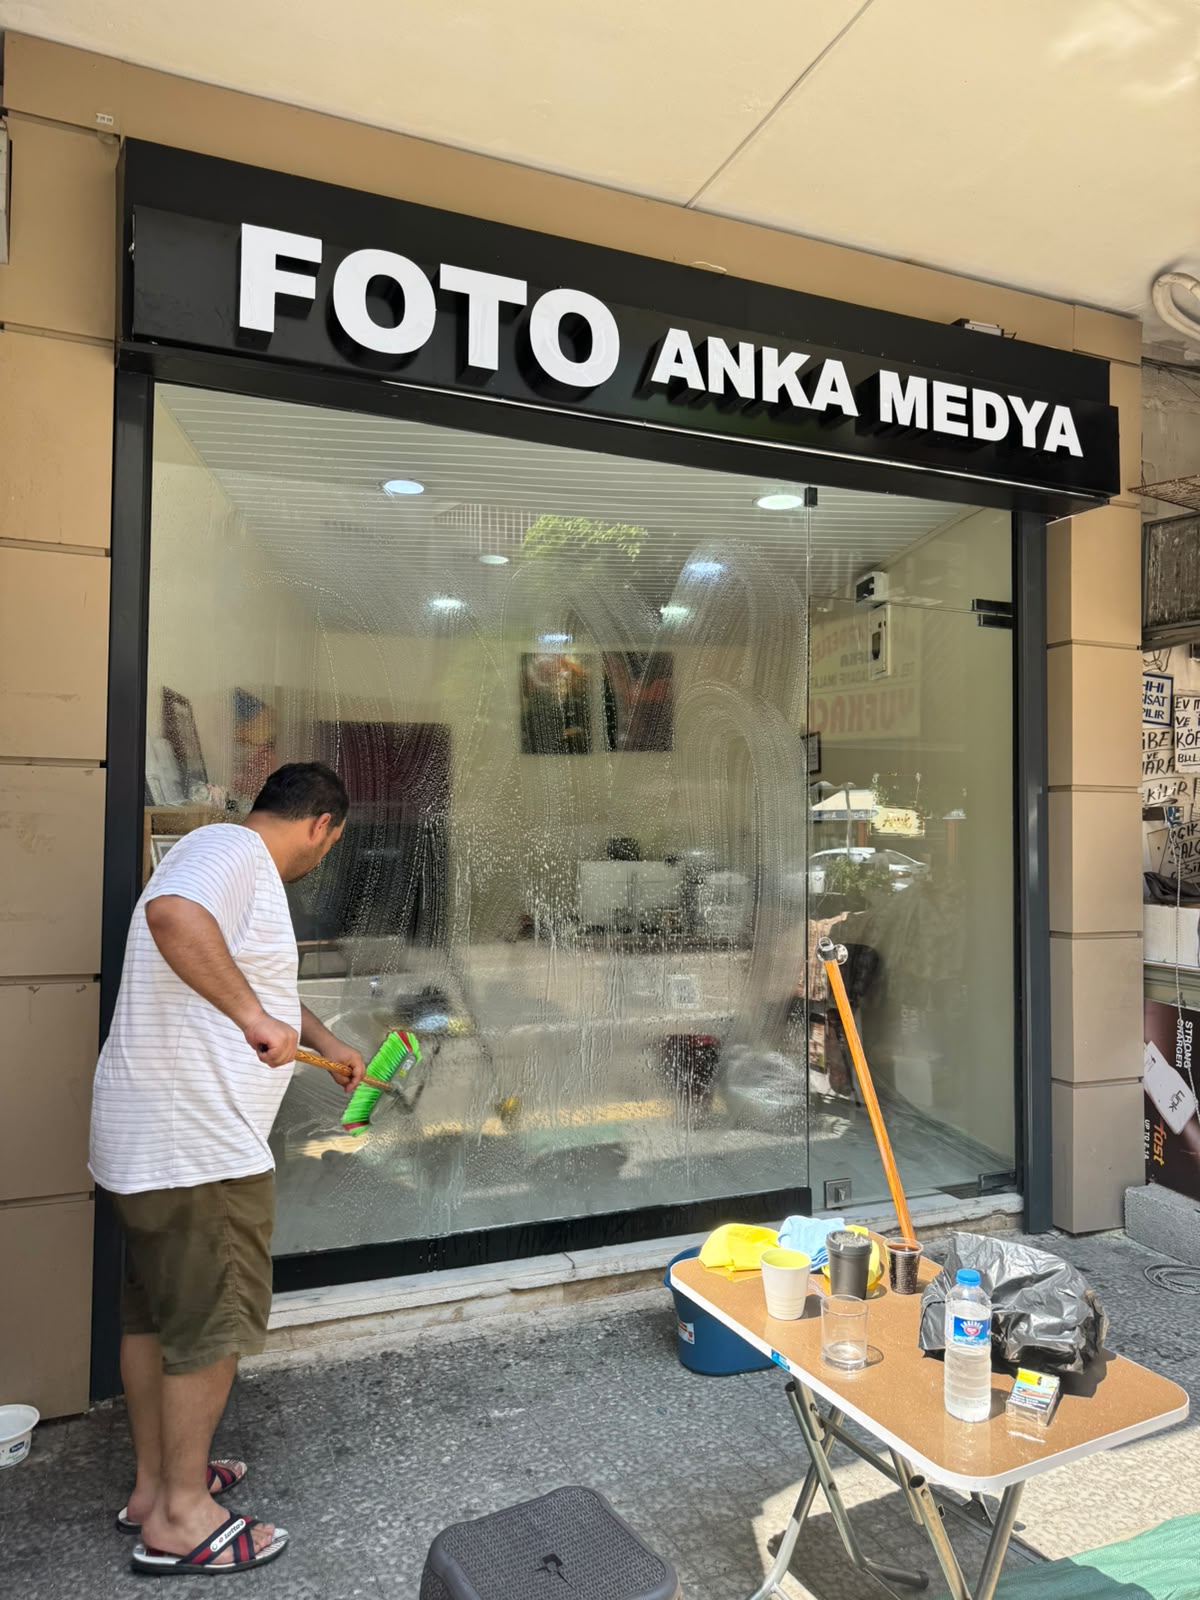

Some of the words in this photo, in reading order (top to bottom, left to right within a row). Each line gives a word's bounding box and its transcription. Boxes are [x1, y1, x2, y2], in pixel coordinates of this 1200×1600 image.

[240, 223, 620, 388] FOTO
[651, 328, 859, 417] ANKA
[879, 369, 1084, 458] MEDYA
[1142, 681, 1164, 693] HHI
[1142, 691, 1168, 707] İSAT
[1175, 697, 1190, 709] EV
[1176, 716, 1191, 727] VE
[1142, 781, 1190, 803] KİLİR
[1176, 1019, 1184, 1068] CHARGER
[1184, 1021, 1193, 1069] STRONG
[1153, 1124, 1167, 1166] fast
